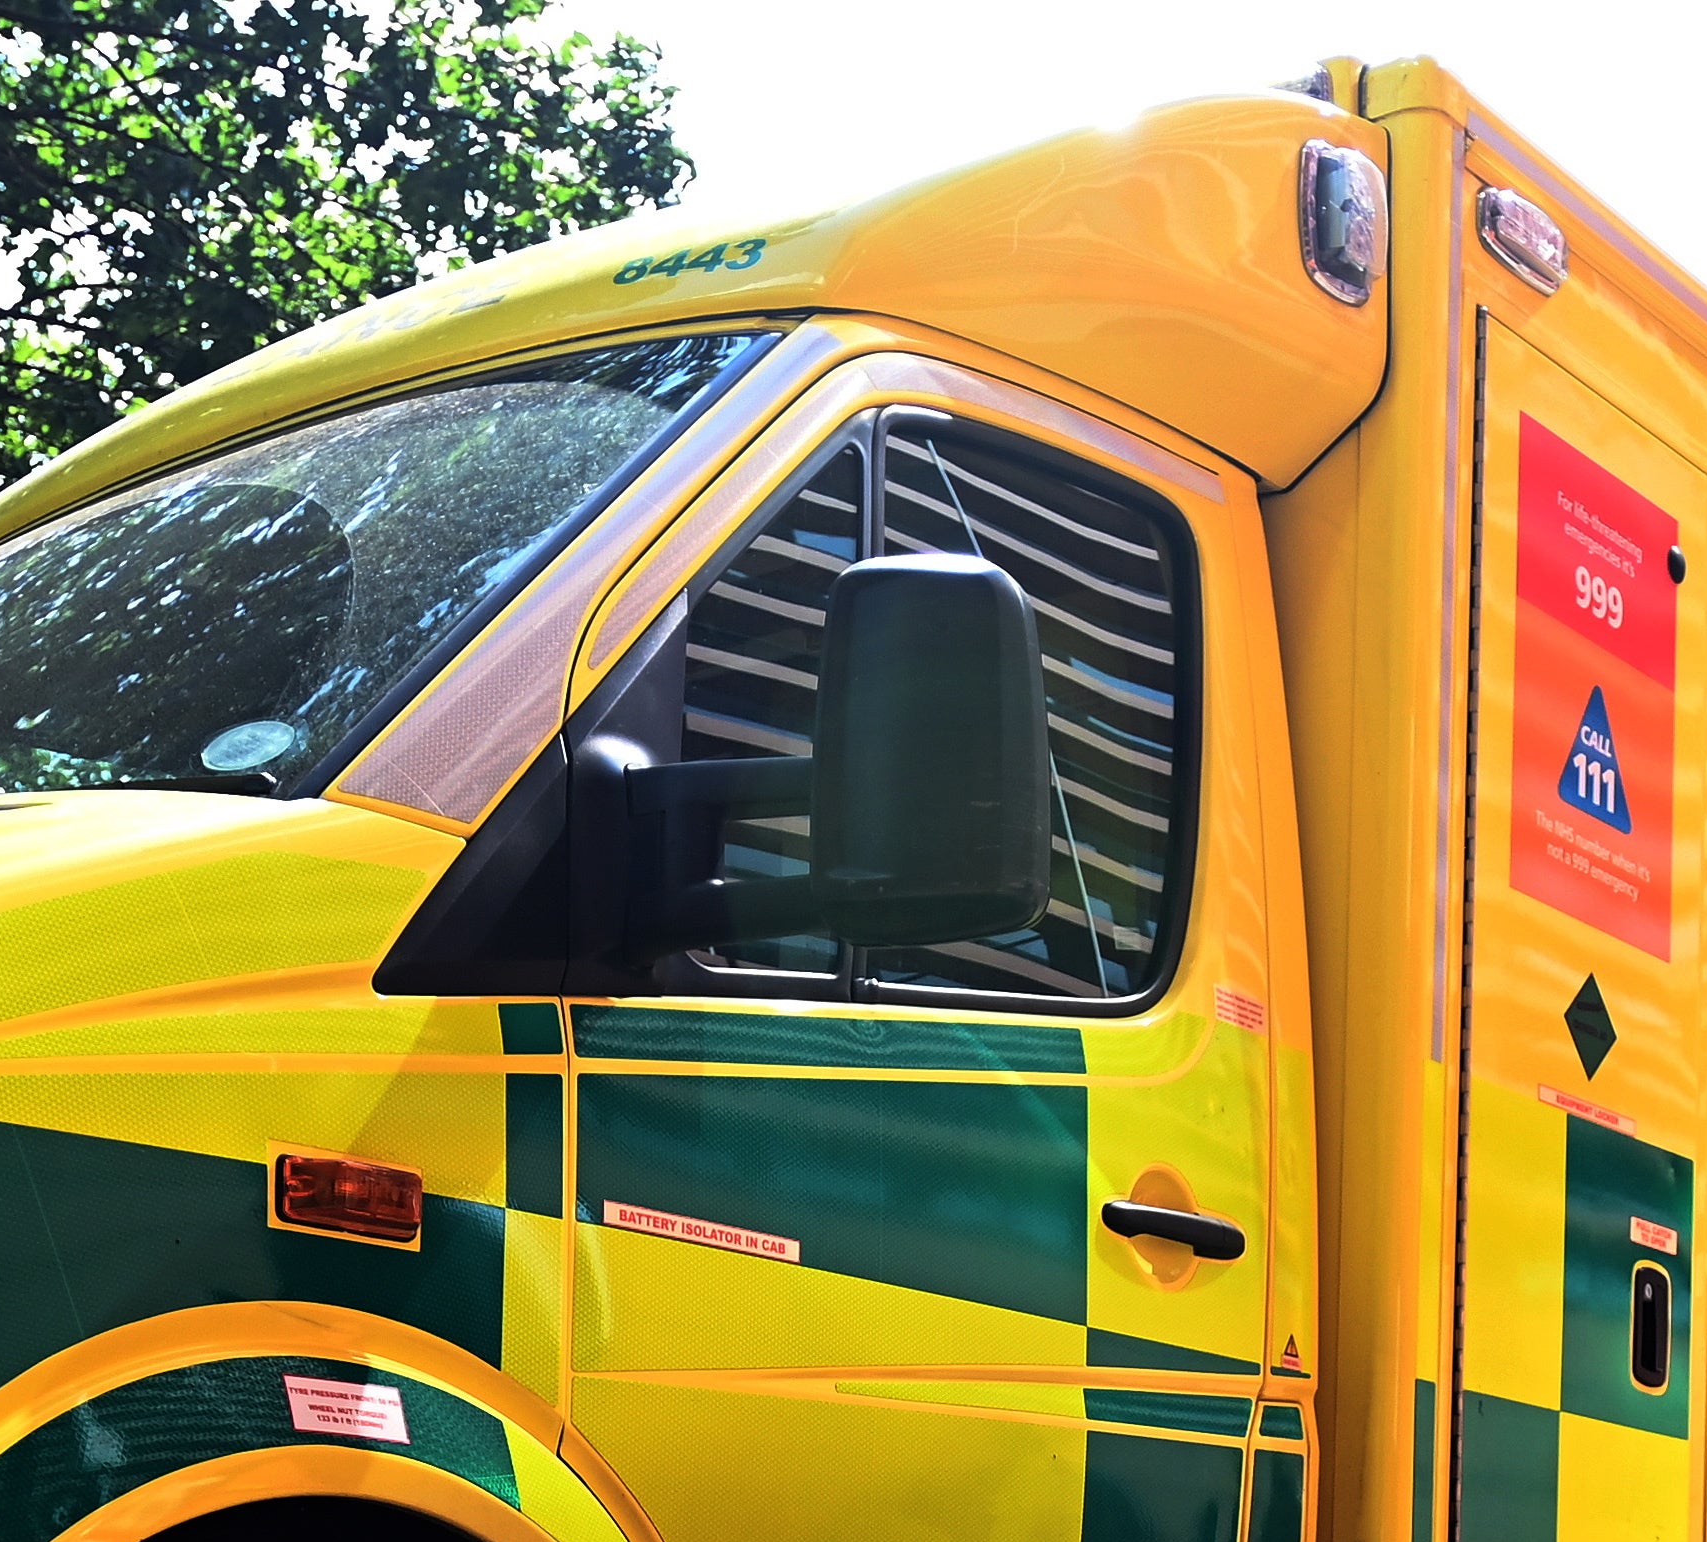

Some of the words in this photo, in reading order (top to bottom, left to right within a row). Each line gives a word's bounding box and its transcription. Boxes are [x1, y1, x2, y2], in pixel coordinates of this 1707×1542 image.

[612, 238, 768, 285] 8443
[1557, 490, 1573, 512] For
[1573, 500, 1643, 564] life-threatening
[1564, 522, 1621, 568] emergencies
[1621, 556, 1635, 578] it's
[1574, 565, 1624, 629] 999
[1580, 725, 1612, 758] CALL
[1572, 752, 1615, 814] 111
[1536, 810, 1553, 833] The
[1554, 820, 1574, 844] NHS
[1575, 835, 1610, 860] number
[1611, 851, 1636, 875] when
[1637, 866, 1651, 883] it's
[1547, 844, 1565, 863] not
[1573, 853, 1590, 874] 999
[1590, 866, 1640, 902] emergency
[619, 1209, 678, 1234] BATTERY
[681, 1222, 742, 1246] ISOLATOR
[745, 1235, 759, 1250] IN
[761, 1238, 786, 1255] CAB
[288, 1386, 309, 1396] TYRE
[311, 1389, 350, 1400] PRESSURE
[308, 1404, 336, 1414] WHEEL
[337, 1406, 353, 1415] NUT
